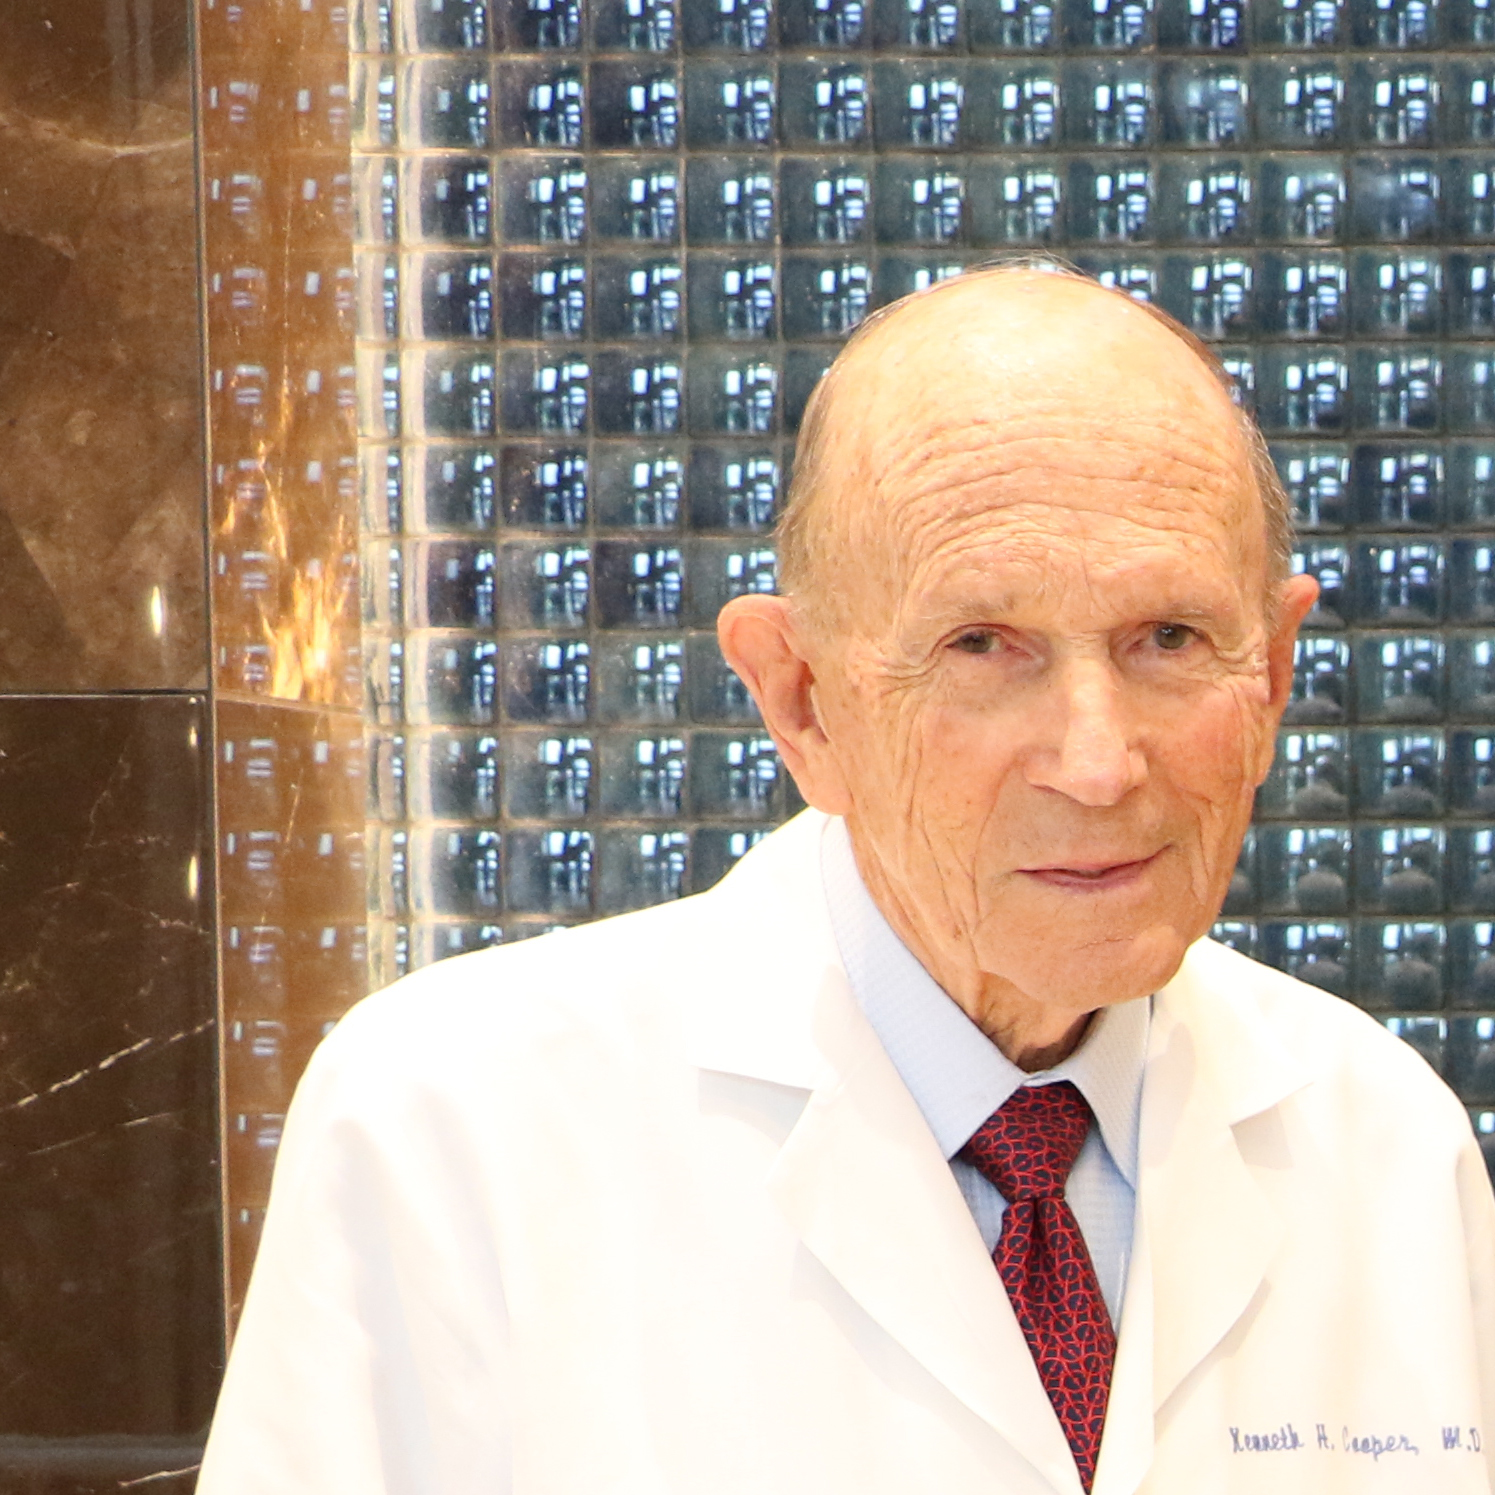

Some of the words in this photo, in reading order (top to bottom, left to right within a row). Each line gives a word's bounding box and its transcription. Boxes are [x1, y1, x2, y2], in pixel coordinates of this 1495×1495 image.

[1229, 1423, 1305, 1453] Kenneth
[1316, 1424, 1335, 1451] H.
[1342, 1426, 1419, 1461] Cooper,
